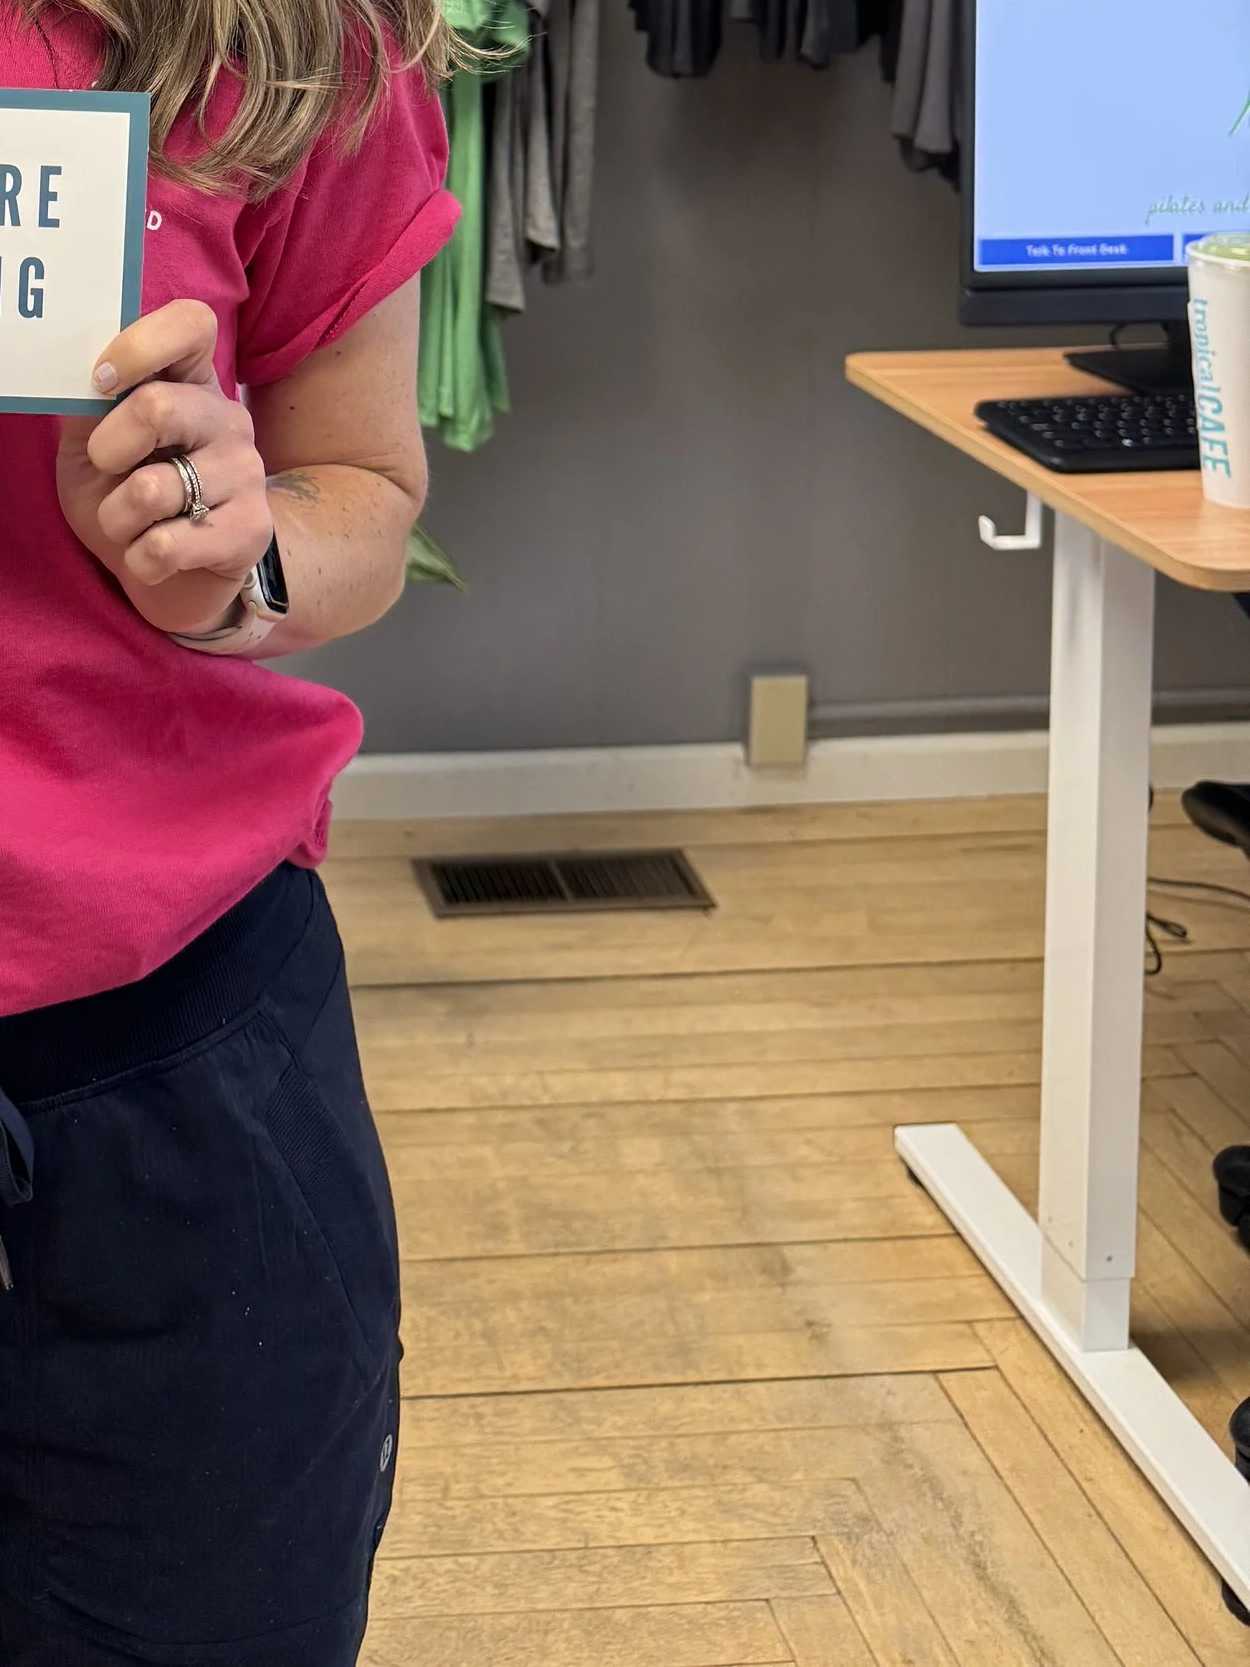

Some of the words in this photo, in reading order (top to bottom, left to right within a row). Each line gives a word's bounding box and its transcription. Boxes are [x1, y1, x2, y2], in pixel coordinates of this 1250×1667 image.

[1145, 194, 1206, 225] pilates
[1213, 193, 1250, 214] and
[1052, 244, 1066, 256] To
[1067, 243, 1097, 256] Front
